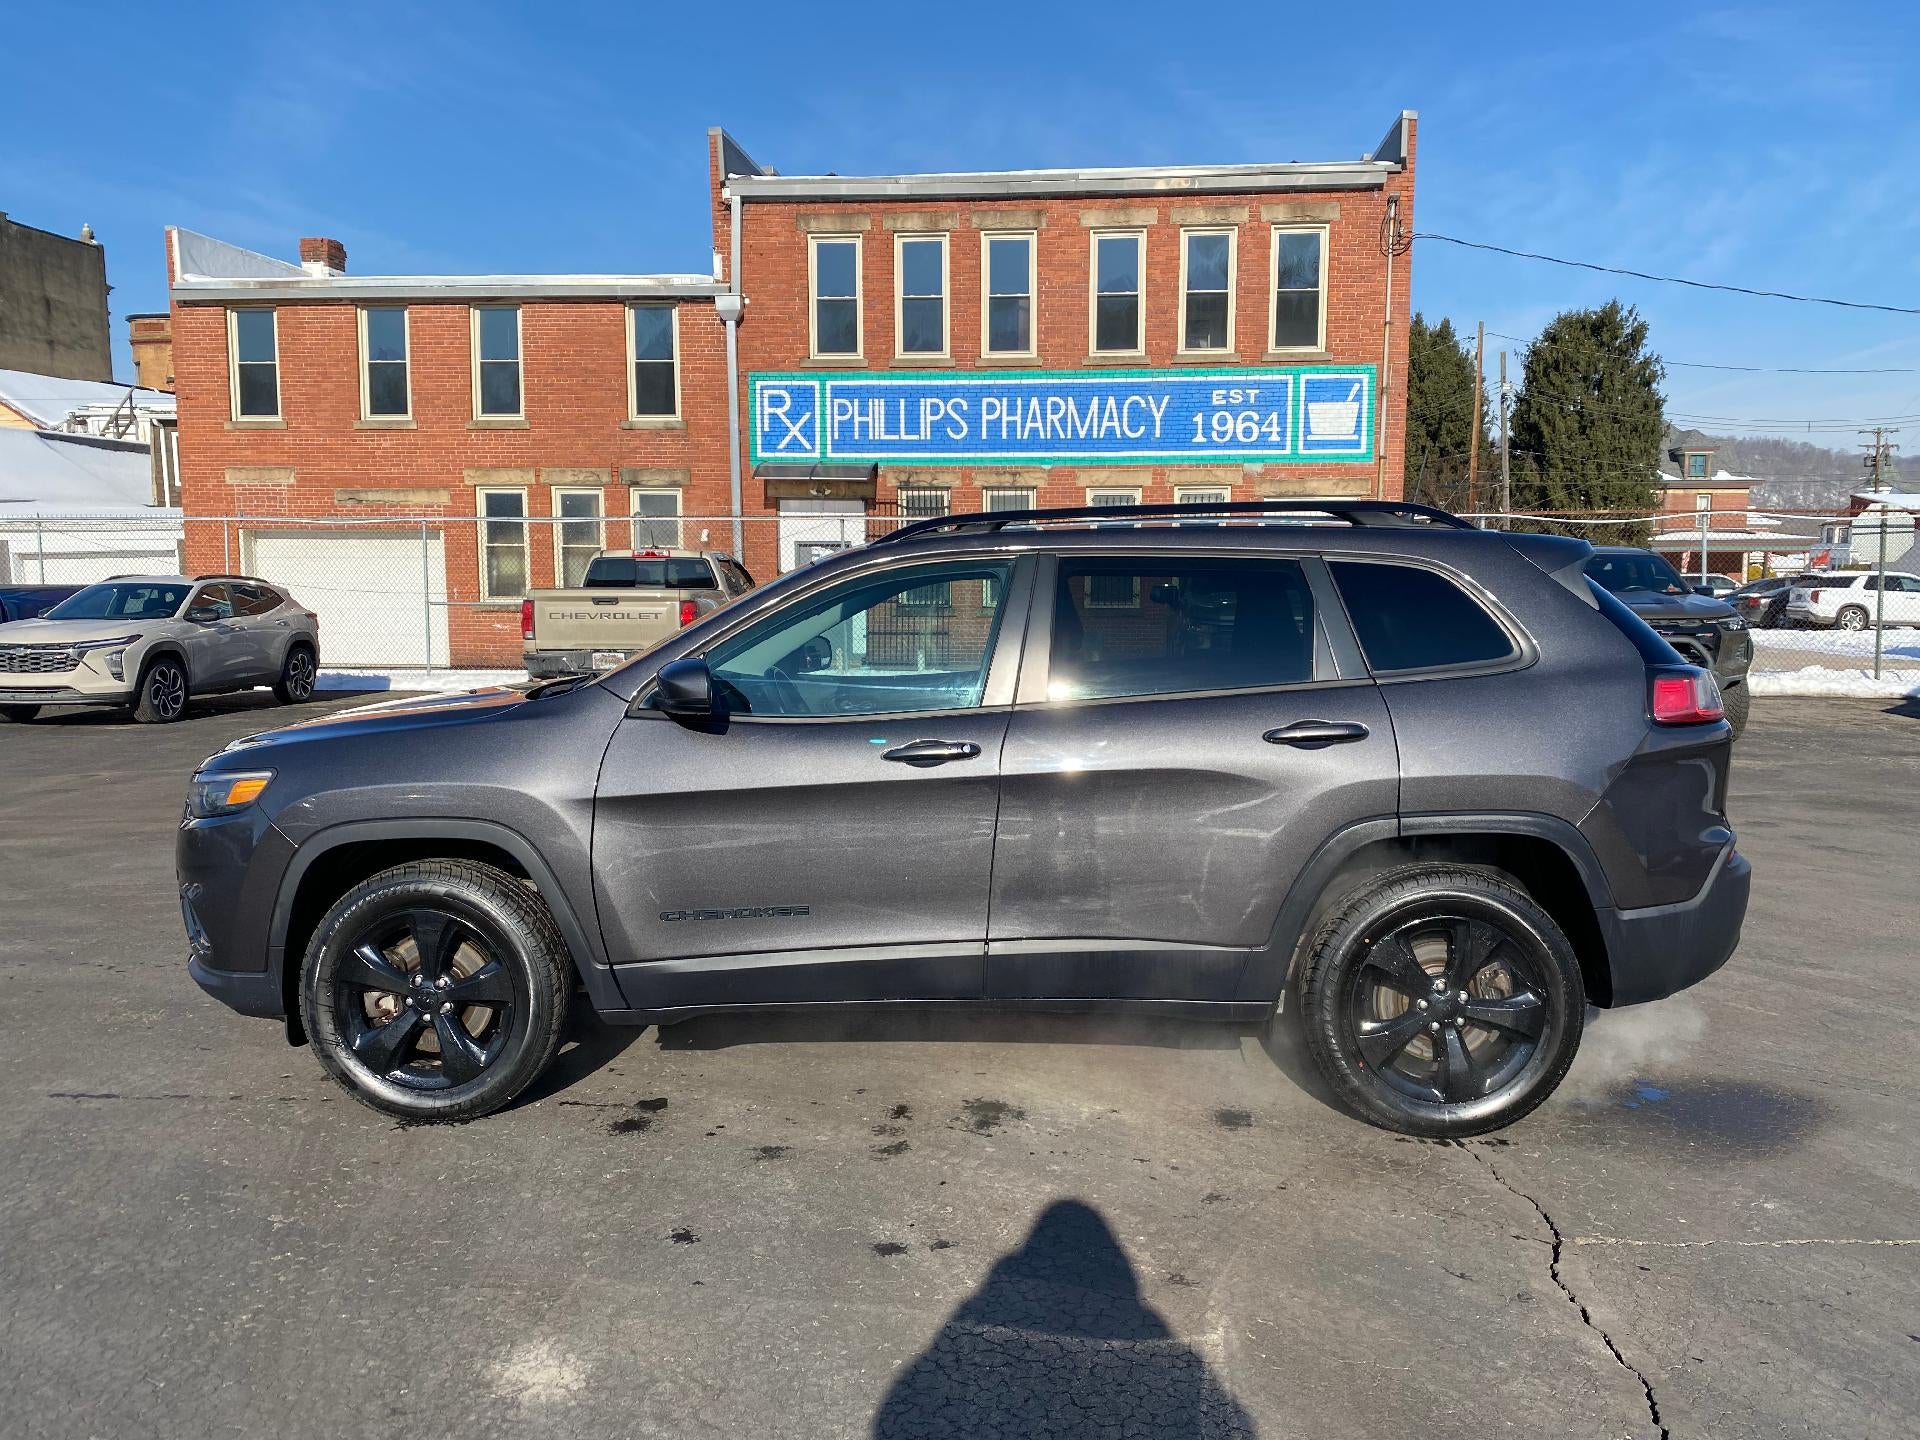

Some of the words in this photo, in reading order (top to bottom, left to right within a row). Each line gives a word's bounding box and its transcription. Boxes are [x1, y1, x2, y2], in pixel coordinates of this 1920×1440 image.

[1212, 389, 1260, 405] EST
[833, 397, 969, 440] PHILLIPS
[982, 395, 1170, 440] PHARMACY
[1192, 410, 1281, 443] 1964
[549, 612, 662, 620] CHEVROLET
[660, 905, 810, 922] CHEROKEE
